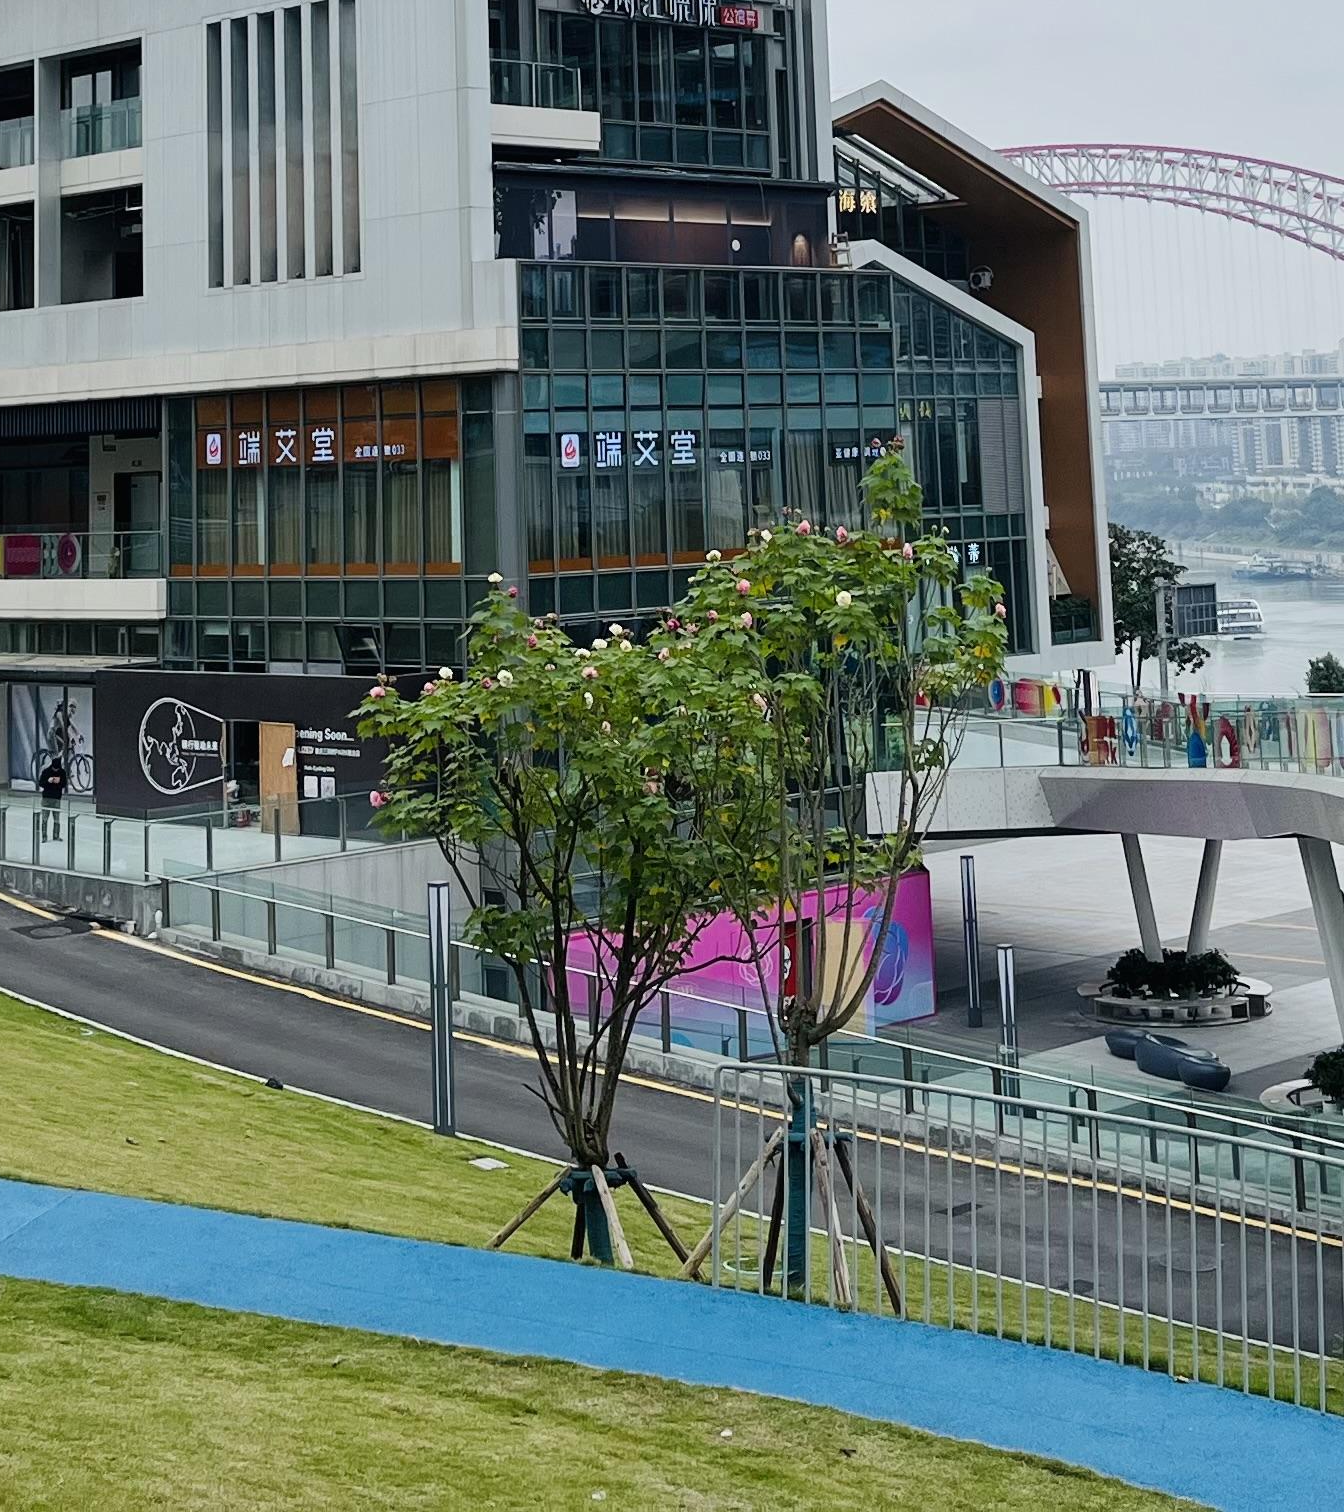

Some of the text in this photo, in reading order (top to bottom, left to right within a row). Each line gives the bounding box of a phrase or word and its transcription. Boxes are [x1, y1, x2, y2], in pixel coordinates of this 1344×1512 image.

[238, 427, 335, 465] 端艾堂
[595, 430, 697, 468] 端艾堂
